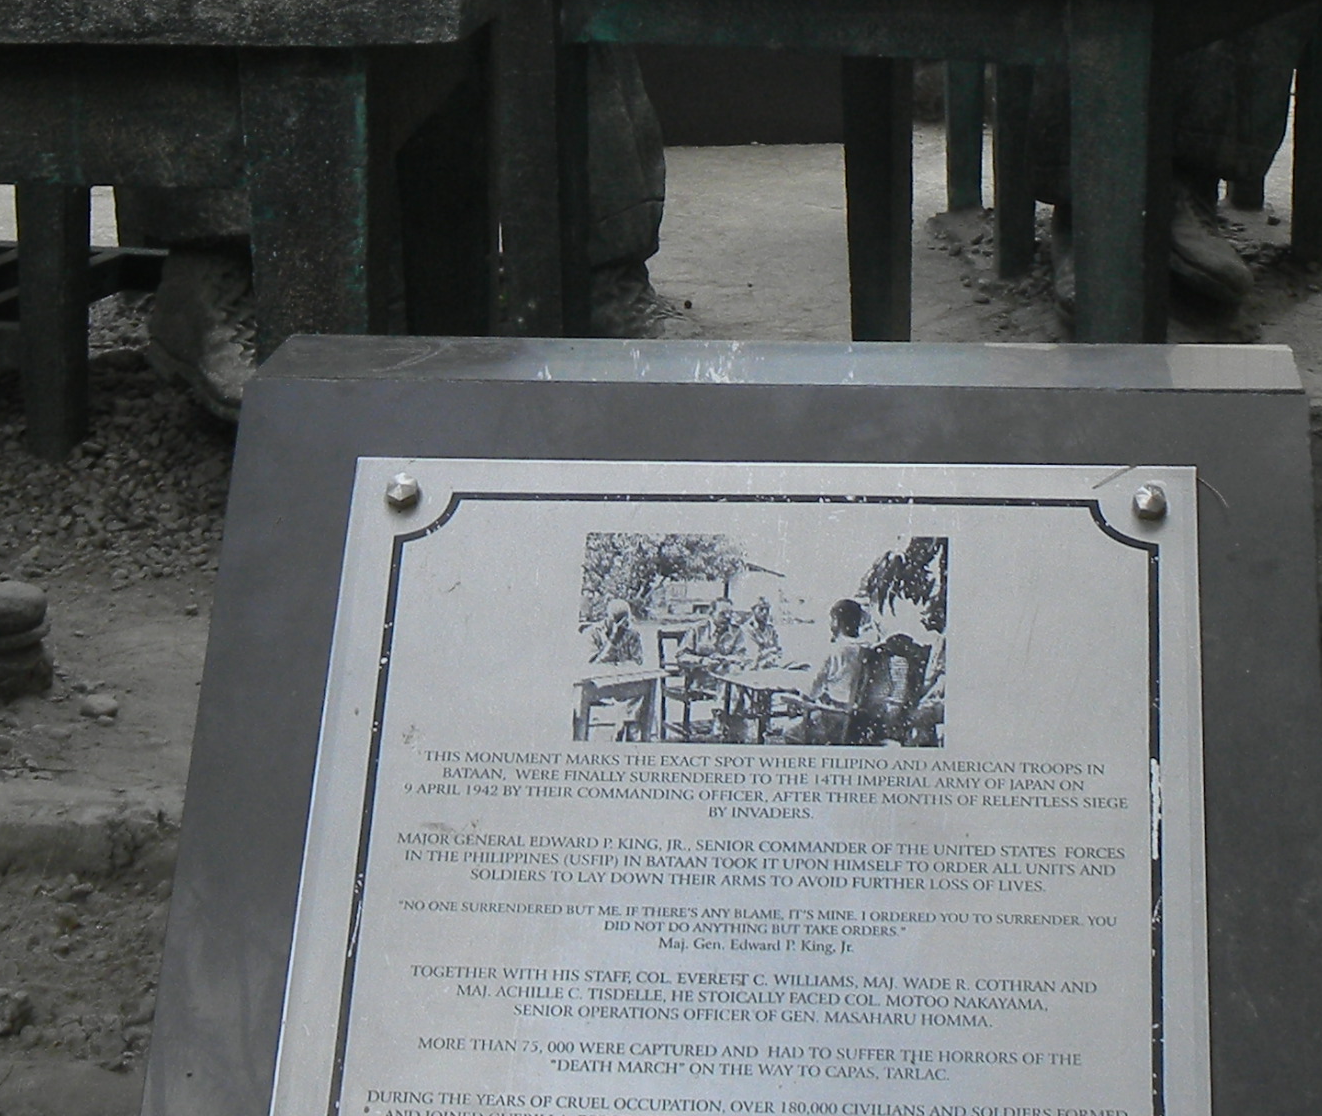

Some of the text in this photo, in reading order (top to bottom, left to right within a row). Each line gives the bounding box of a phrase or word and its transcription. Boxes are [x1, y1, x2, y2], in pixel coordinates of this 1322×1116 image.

[424, 750, 1082, 776] THIS MONUMENT MARKS THE EXACT SPOT WHERE FILIPINO AND AMERICAN TROOPS
[516, 767, 559, 780] WERE
[564, 769, 627, 783] FINALLY
[629, 770, 746, 785] SURRENDERED
[749, 772, 772, 785] TO
[775, 773, 809, 786] THE
[815, 774, 855, 787] 14TH
[857, 775, 931, 789] IMPERIAL
[934, 776, 981, 790] ARMY
[1010, 778, 1055, 793] JAPAN
[416, 783, 460, 795] APRIL
[467, 784, 498, 796] 1942
[525, 785, 573, 798] THEIR
[577, 786, 694, 800] COMMANDING
[771, 790, 822, 803] AFTER
[825, 792, 877, 804] THREE
[881, 793, 952, 805] MONTHS
[983, 795, 1078, 808] RELENTLESS
[1083, 797, 1128, 809] SIEGE
[709, 806, 727, 818] BY
[397, 833, 450, 849] MAJOR
[455, 834, 525, 848] GENERAL
[530, 836, 599, 850] EDWARD
[696, 839, 755, 853] SENIOR
[759, 840, 867, 855] COMMANDER
[896, 843, 929, 856] THE
[934, 844, 996, 858] UNITED
[1000, 846, 1056, 860] STATES
[1065, 847, 1125, 861] FORCES
[426, 850, 1115, 877] THE PHILIPPINES (USFIP) BATAAN TOOK UPON HIMSELF TO ORDER ALL UNITS AND
[471, 867, 546, 881] SOLDIERS
[550, 868, 573, 881] TO
[578, 869, 606, 882] LAY
[611, 870, 664, 884] DOWN
[667, 871, 716, 885] THEIR
[720, 873, 766, 886] ARMS
[770, 874, 793, 887] TO
[797, 874, 848, 888] AVOID
[852, 876, 925, 890] FURTHER
[930, 878, 968, 891] LOSS
[973, 879, 994, 892] OF
[428, 901, 457, 912] ONE
[461, 902, 562, 914] SURRENDERED
[566, 904, 595, 915] BUT
[641, 906, 698, 917] THERE'S
[701, 907, 730, 918] ANY
[789, 909, 814, 920] IT'S
[870, 911, 936, 923] ORDERED
[940, 913, 969, 923] YOU
[1088, 916, 1116, 927] YOU
[604, 920, 838, 936] DID NOT ANYTHING BUT TAKE
[731, 938, 780, 951] Edward
[411, 965, 497, 980] TOGETHER
[503, 968, 547, 981] WITH
[552, 969, 580, 982] HIS
[903, 977, 951, 991] WADE
[975, 979, 1055, 993] COTHRAN
[1060, 981, 1097, 994] AND
[495, 985, 564, 1000] ACHILLE
[671, 989, 694, 1003] HE
[698, 990, 785, 1005] STOICALLY
[790, 992, 840, 1007] FACED
[886, 994, 949, 1010] MOTOO
[513, 1004, 573, 1017] SENIOR
[578, 1005, 679, 1020] OPERATIONS
[683, 1007, 750, 1021] OFFICER
[754, 1009, 777, 1022] OF
[824, 1010, 916, 1025] MASAHARU
[418, 1037, 465, 1051] MORE
[470, 1039, 517, 1052] THAN
[579, 1041, 625, 1055] WERE
[629, 1043, 717, 1057] CAPTURED
[721, 1045, 759, 1058] AND
[768, 1046, 804, 1059] HAD
[808, 1047, 832, 1060] TO
[836, 1048, 896, 1061] SUFFER
[900, 1049, 933, 1062] THE
[939, 1050, 1018, 1064] HORRORS
[1022, 1052, 1044, 1065] OF
[1048, 1053, 1081, 1066] THE
[689, 1062, 715, 1075] ON
[719, 1063, 753, 1076] THE
[758, 1064, 794, 1077] WAY
[797, 1064, 821, 1077] TO
[367, 1090, 433, 1104] DURING
[438, 1092, 471, 1105] THE
[476, 1093, 525, 1107] YEARS
[530, 1095, 552, 1108] OF
[556, 1095, 609, 1109] CRUEL
[730, 1100, 774, 1114] OVER
[782, 1101, 838, 1116] 180,000
[842, 1103, 925, 1116] CIVILIANS
[929, 1105, 966, 1116] AND
